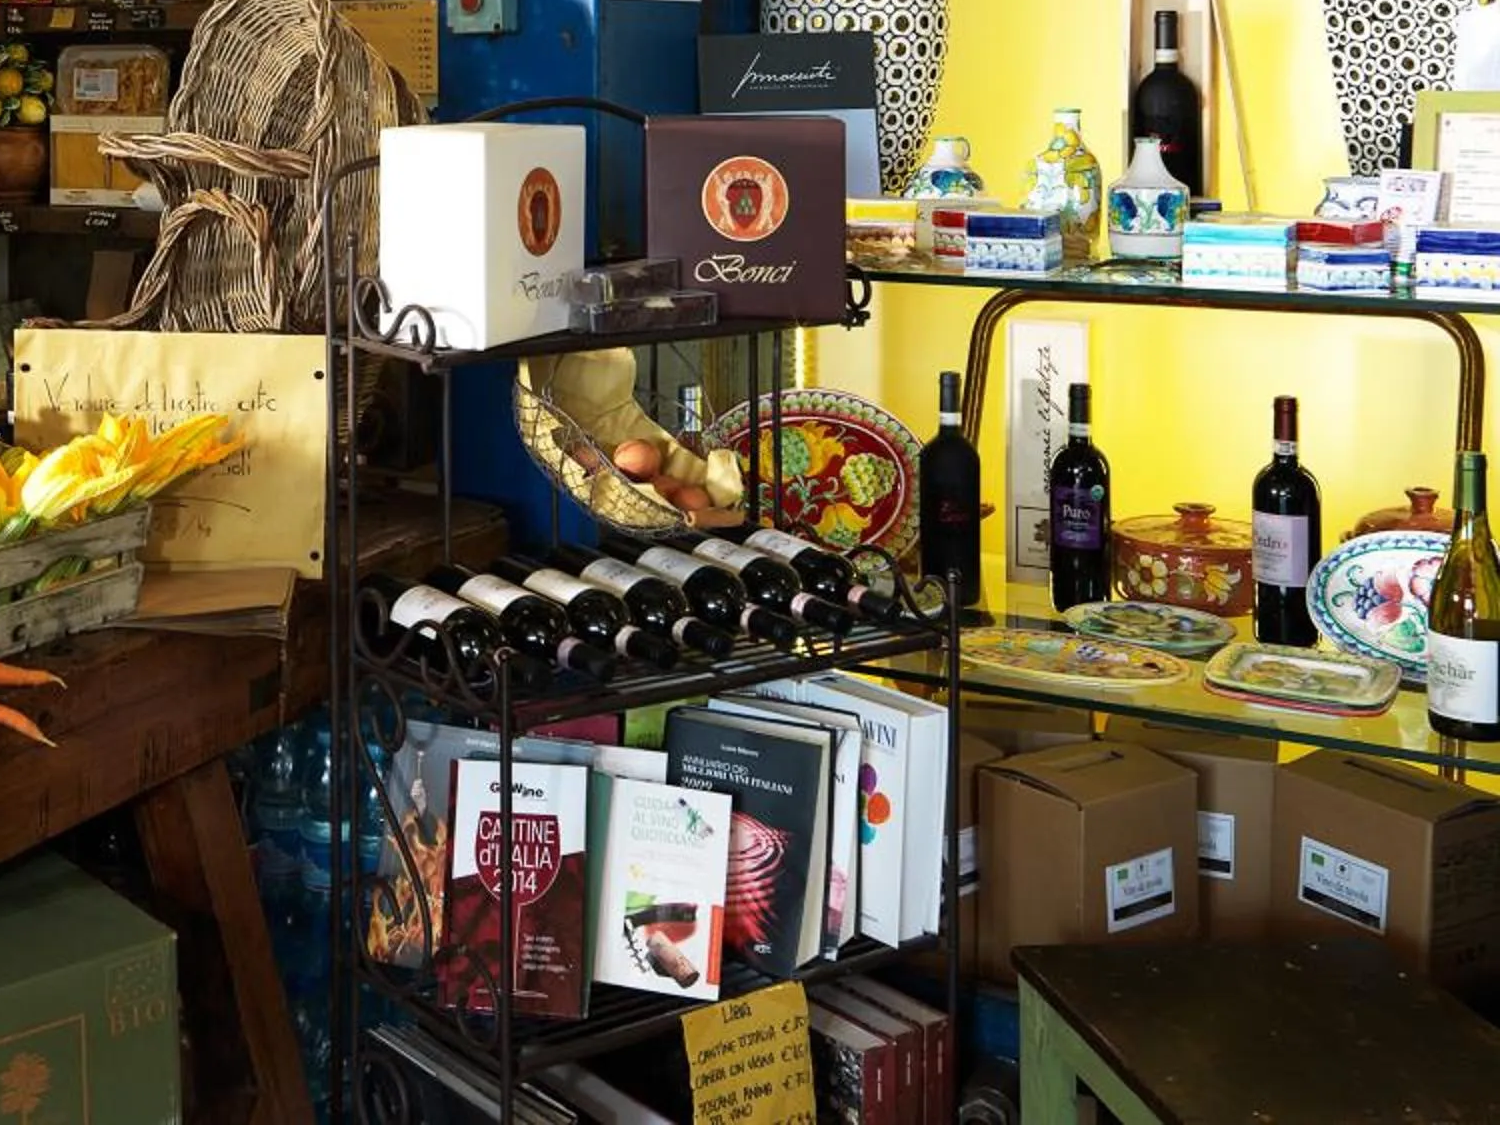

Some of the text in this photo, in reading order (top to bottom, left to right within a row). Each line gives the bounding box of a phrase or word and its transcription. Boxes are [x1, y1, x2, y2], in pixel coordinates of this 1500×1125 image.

[693, 253, 798, 286] Bonci
[489, 781, 544, 800] GWine
[479, 843, 553, 870] d'IALIA
[110, 998, 167, 1036] BIO
